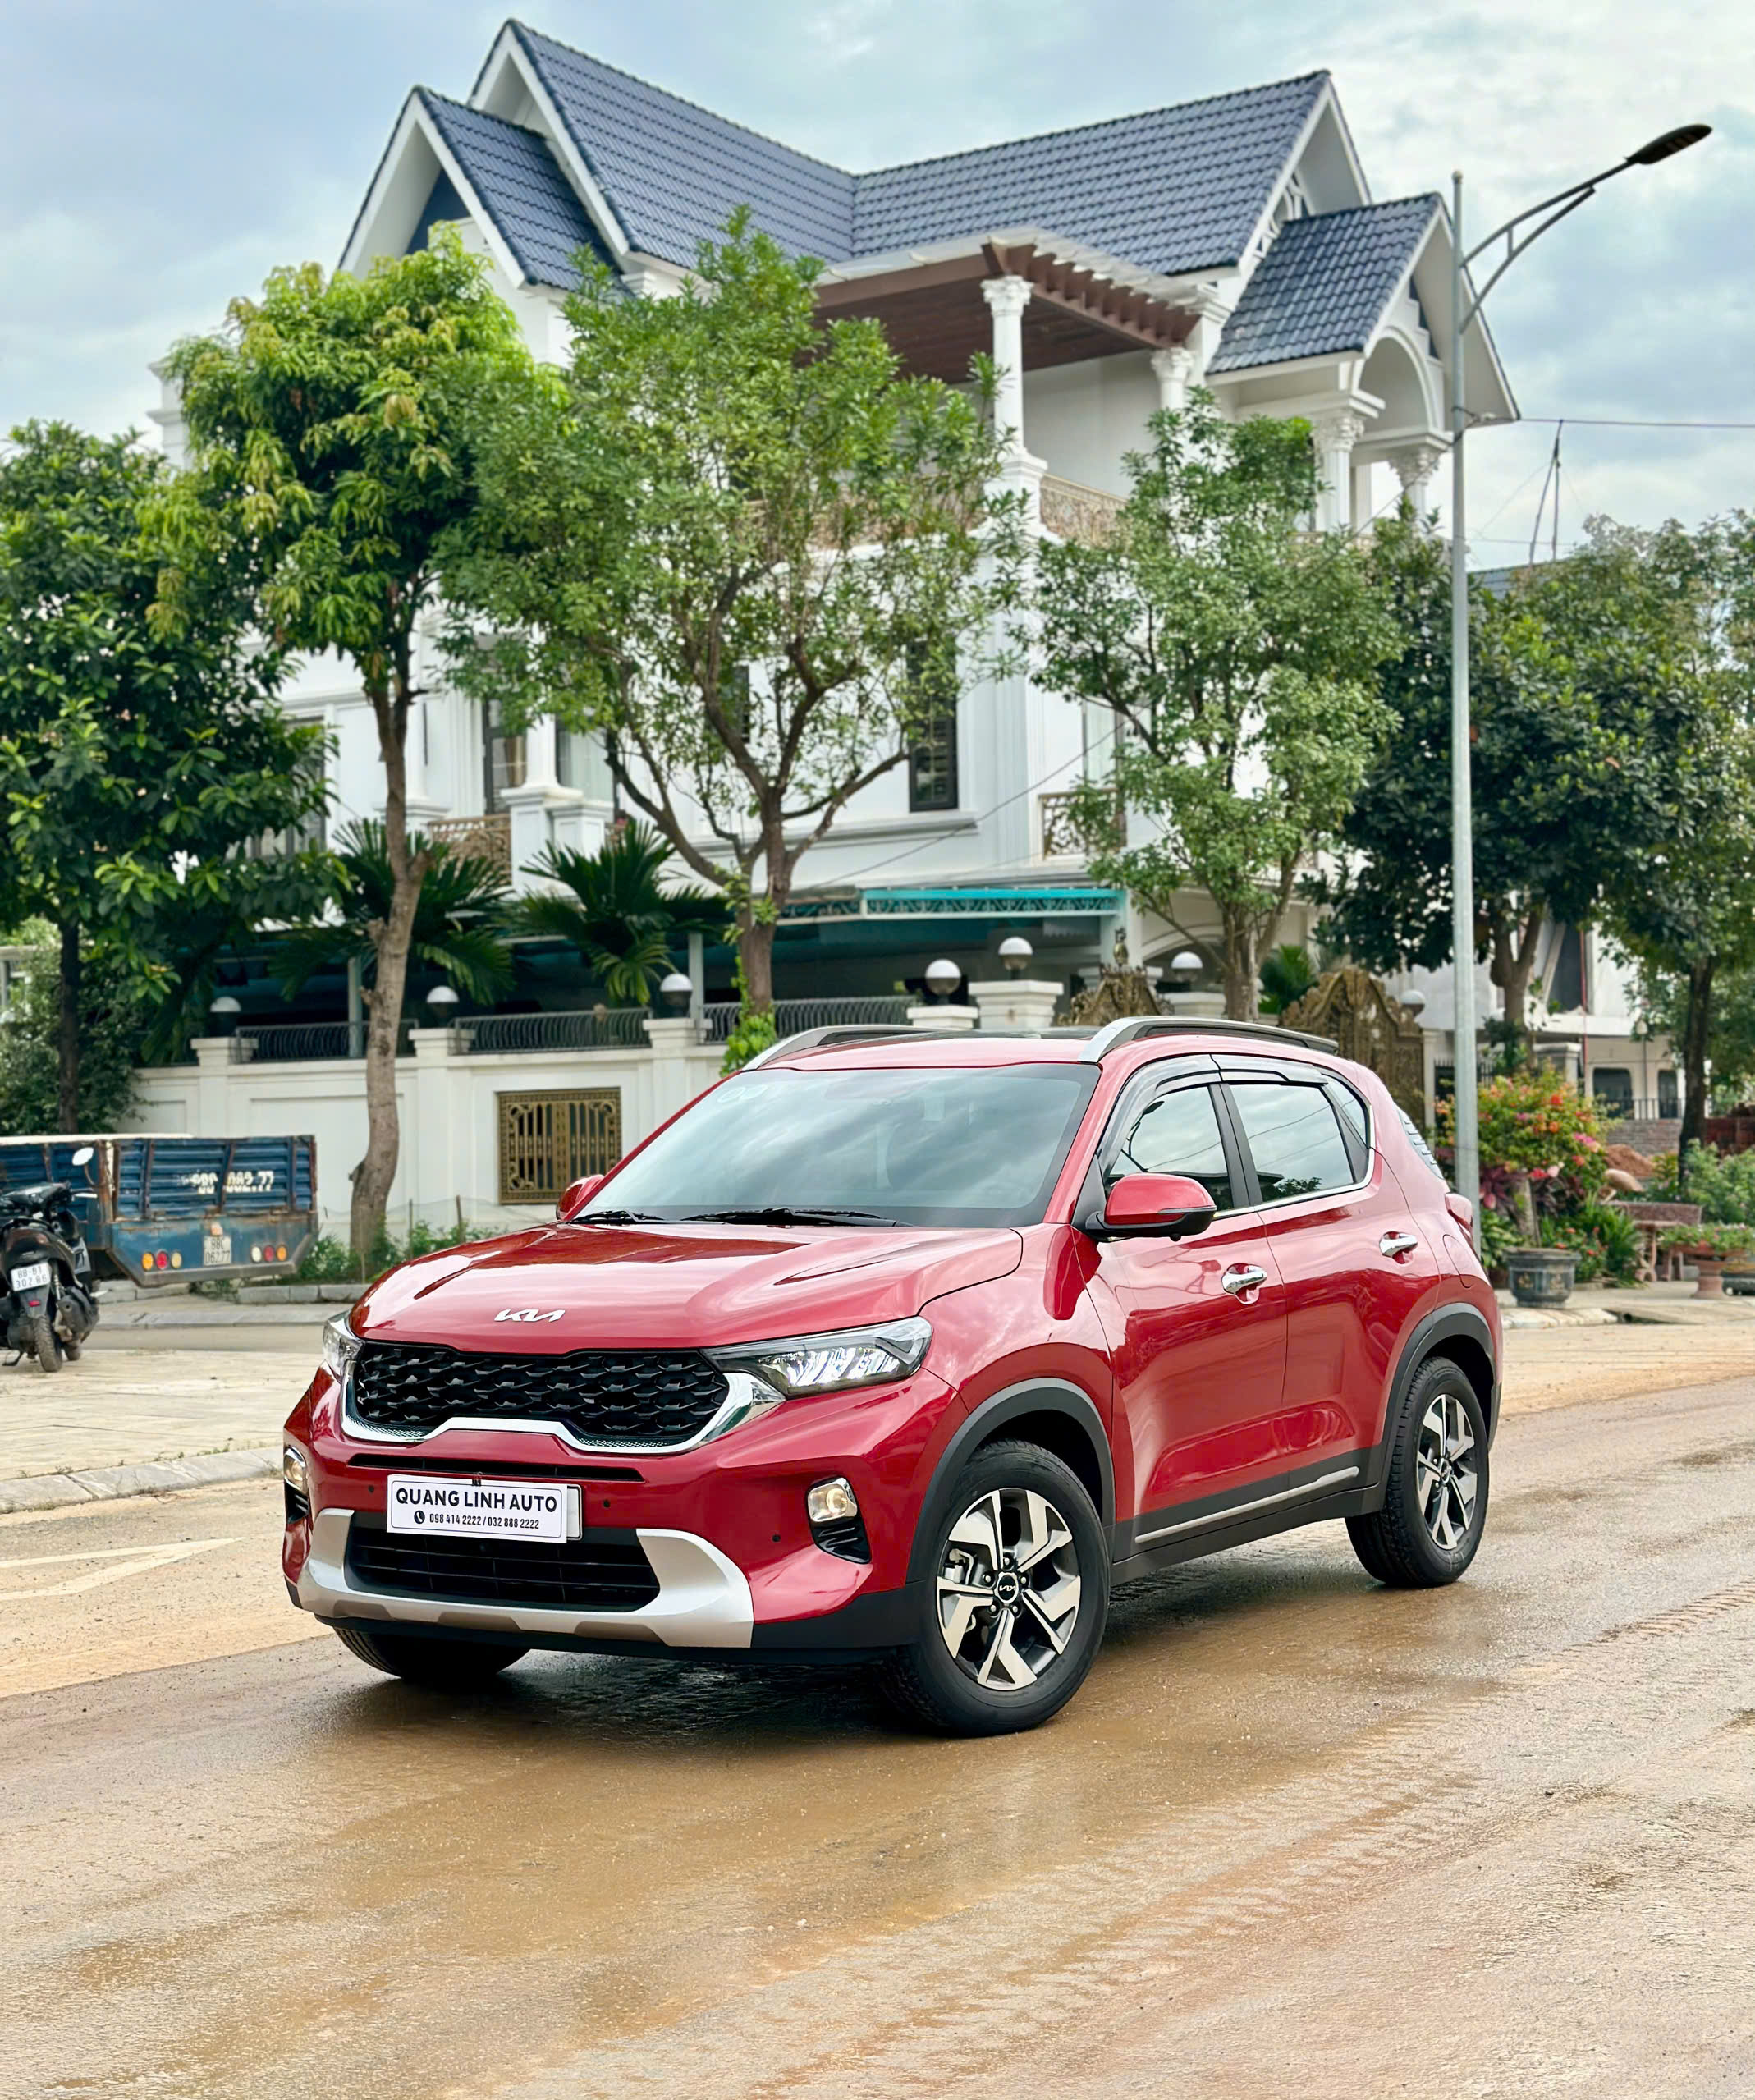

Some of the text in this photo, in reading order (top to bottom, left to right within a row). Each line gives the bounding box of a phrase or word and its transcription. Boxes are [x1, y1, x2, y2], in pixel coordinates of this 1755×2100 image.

[493, 1309, 566, 1323] KIA
[396, 1488, 557, 1512] QUANG LINH AUTO
[429, 1513, 444, 1524] 098
[446, 1514, 461, 1525] 414
[462, 1515, 482, 1526] 2222
[488, 1516, 502, 1527] 032
[504, 1517, 519, 1528] 888
[520, 1518, 539, 1529] 2222
